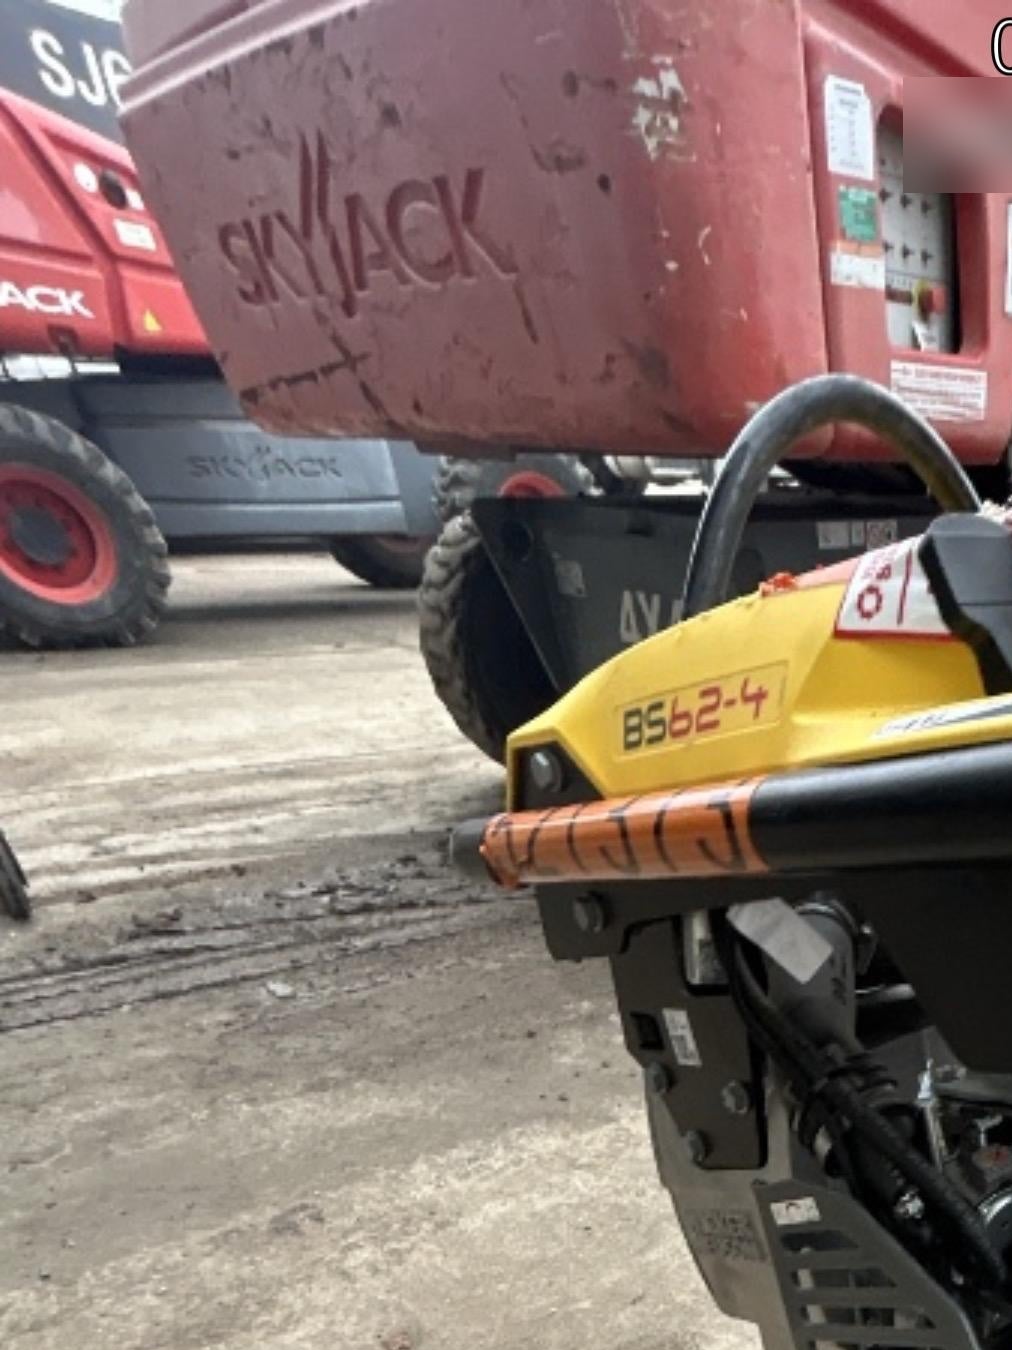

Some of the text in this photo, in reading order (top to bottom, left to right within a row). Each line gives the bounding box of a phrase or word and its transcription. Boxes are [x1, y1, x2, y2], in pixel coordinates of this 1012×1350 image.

[217, 128, 519, 319] SKYJACK
[187, 445, 343, 482] SKYJACK
[623, 677, 768, 751] BS62-4
